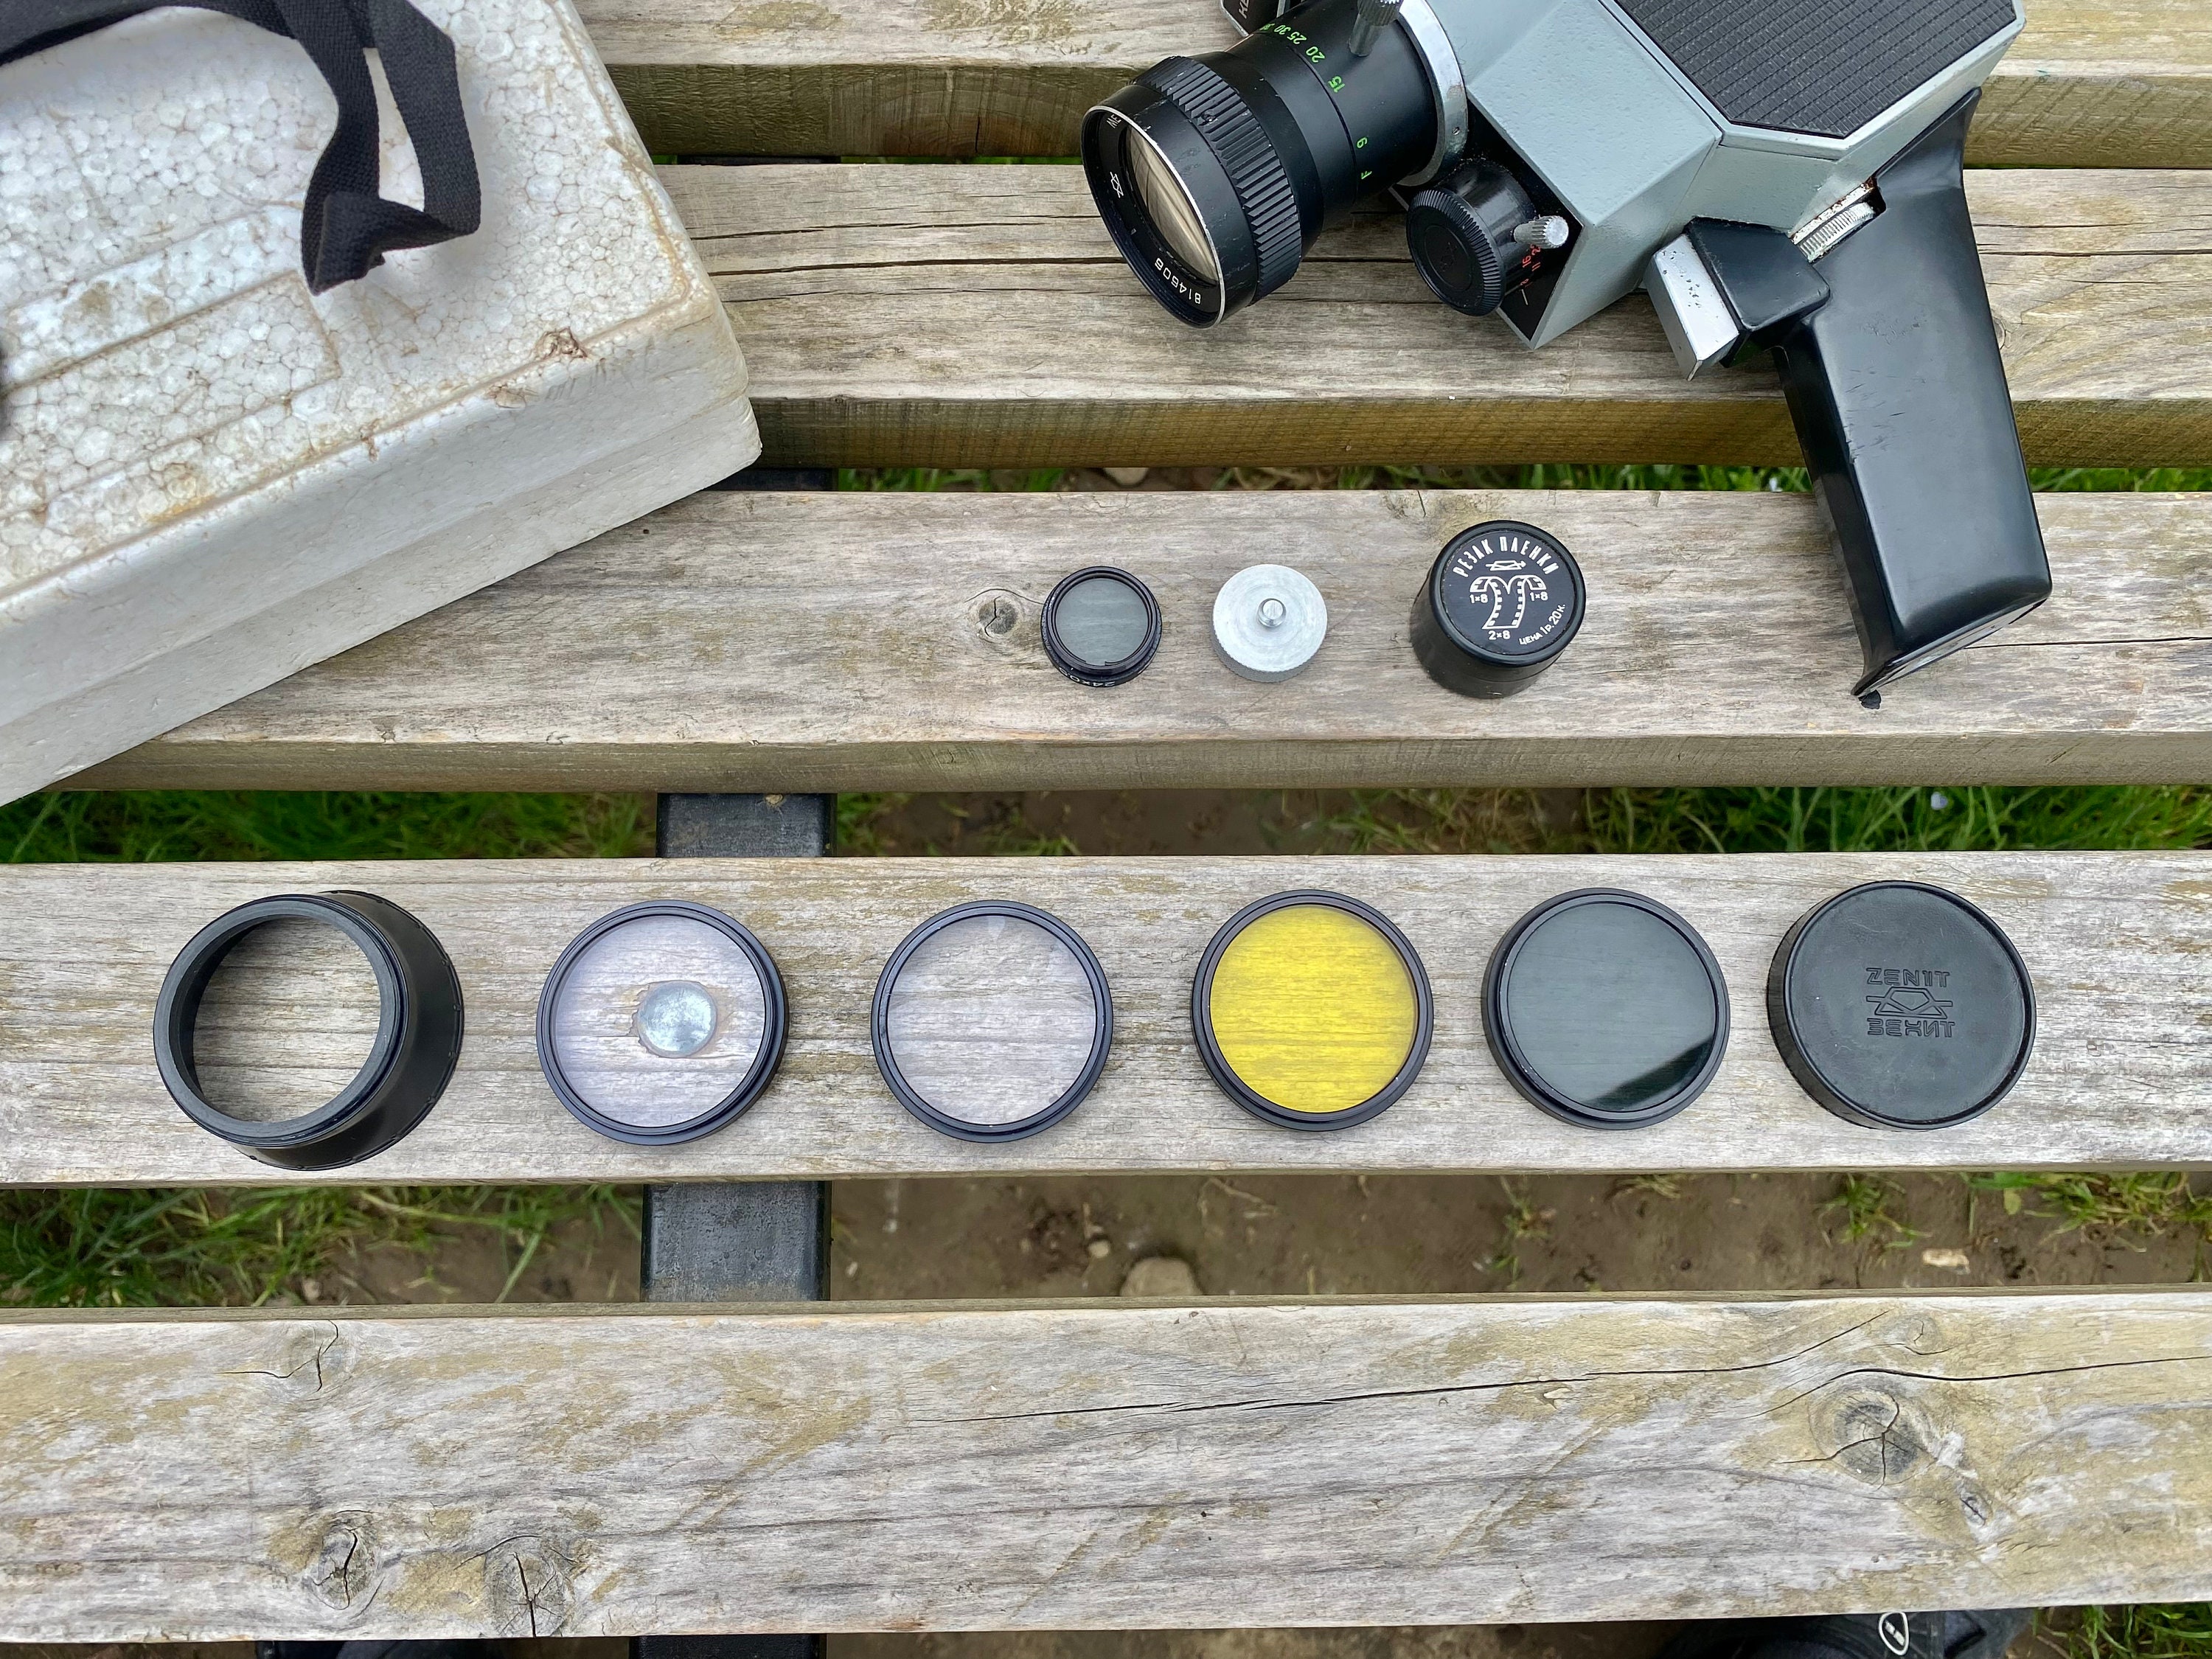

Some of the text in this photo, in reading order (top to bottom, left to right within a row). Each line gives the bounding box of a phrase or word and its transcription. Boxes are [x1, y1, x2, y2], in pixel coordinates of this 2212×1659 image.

[1273, 24, 1292, 35] 30
[1287, 31, 1307, 45] 25
[1305, 46, 1326, 63] 20
[1327, 75, 1346, 93] 15
[1522, 255, 1531, 268] 16
[1155, 257, 1201, 305] 814606
[1453, 536, 1559, 577] РЕЗАК ПЛЕНКИ
[1518, 632, 1543, 645] ЦЕНА
[1865, 967, 1950, 987] ZENIT
[1866, 1018, 1955, 1037] ЗЕНИТ
